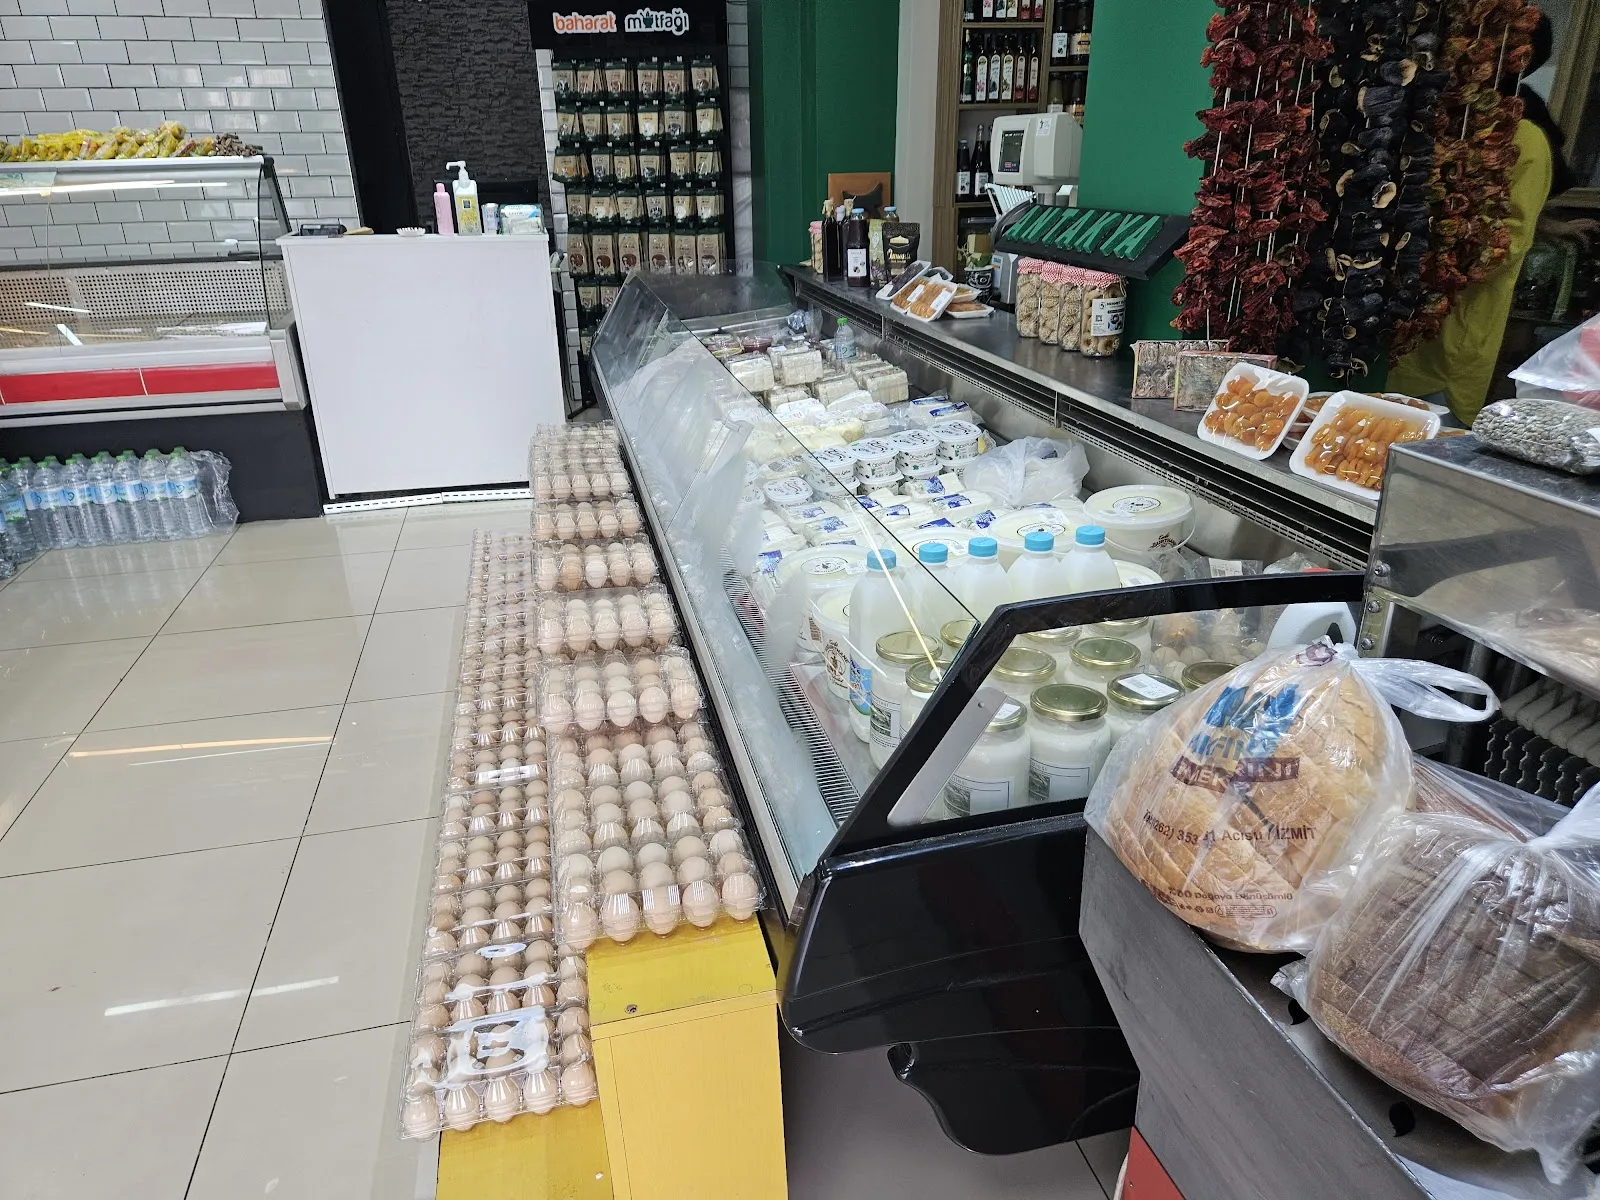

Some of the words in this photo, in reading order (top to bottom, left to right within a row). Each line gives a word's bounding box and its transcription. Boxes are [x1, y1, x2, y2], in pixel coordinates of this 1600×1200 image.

[554, 12, 616, 32] baharat
[1002, 204, 1164, 261] ANTAKYA
[1177, 829, 1199, 845] 353
